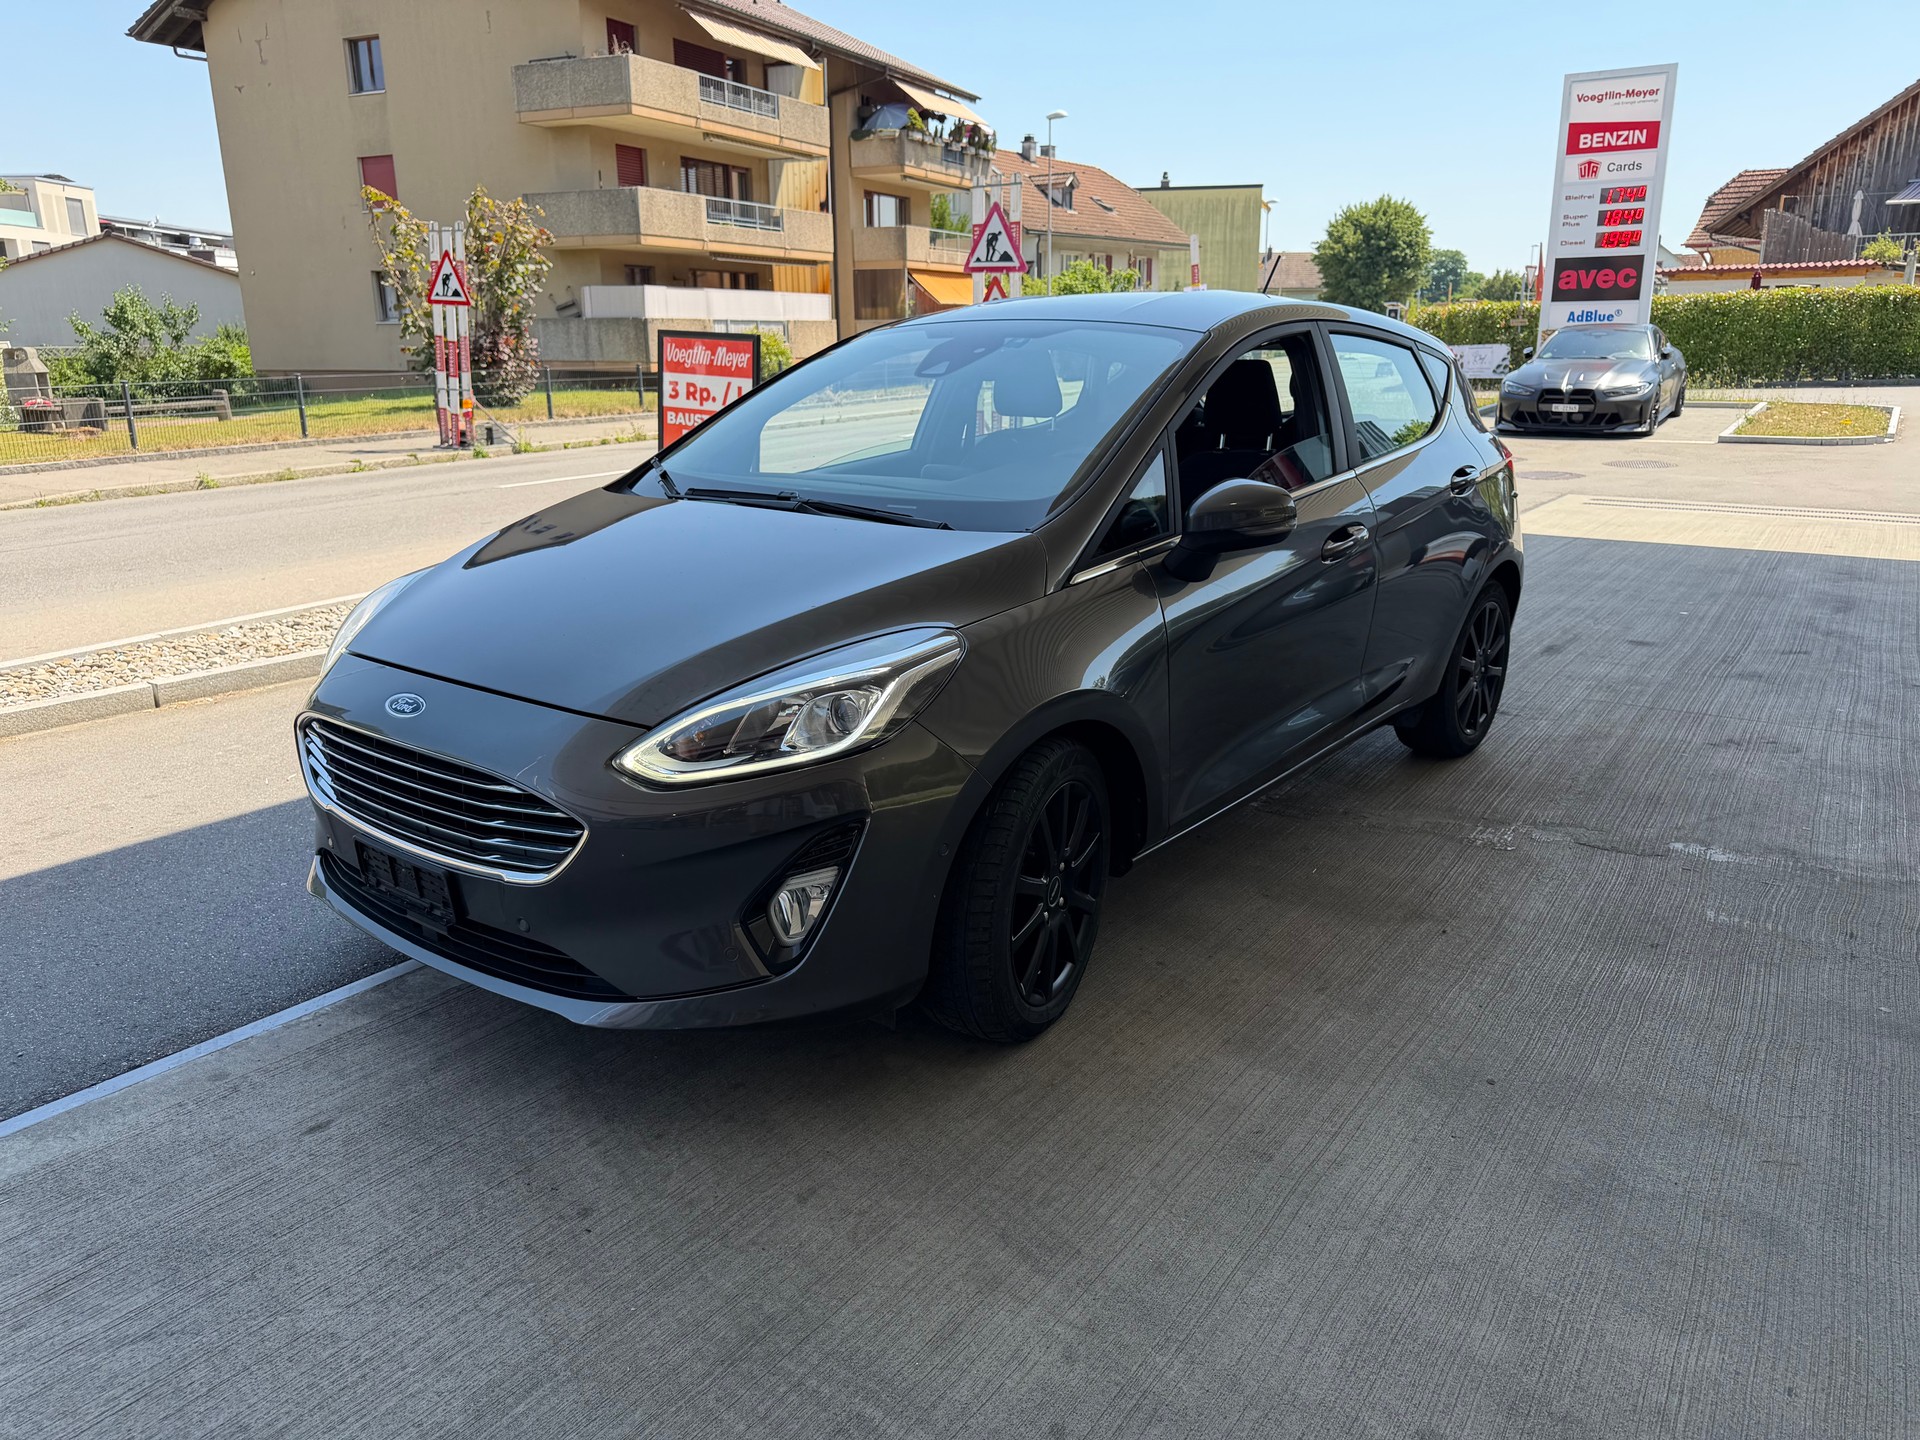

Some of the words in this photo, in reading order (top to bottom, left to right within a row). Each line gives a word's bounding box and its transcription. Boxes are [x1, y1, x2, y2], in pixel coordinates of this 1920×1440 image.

[1576, 88, 1660, 104] Voegtlin-Meyer
[1578, 129, 1647, 149] BENZIN
[1607, 161, 1643, 172] Cards
[1558, 268, 1638, 290] avec
[666, 343, 751, 371] Voegtlin-Meyer
[668, 381, 679, 399] 3
[685, 382, 717, 407] Rp.
[722, 381, 732, 406] /
[391, 697, 417, 713] Ford
